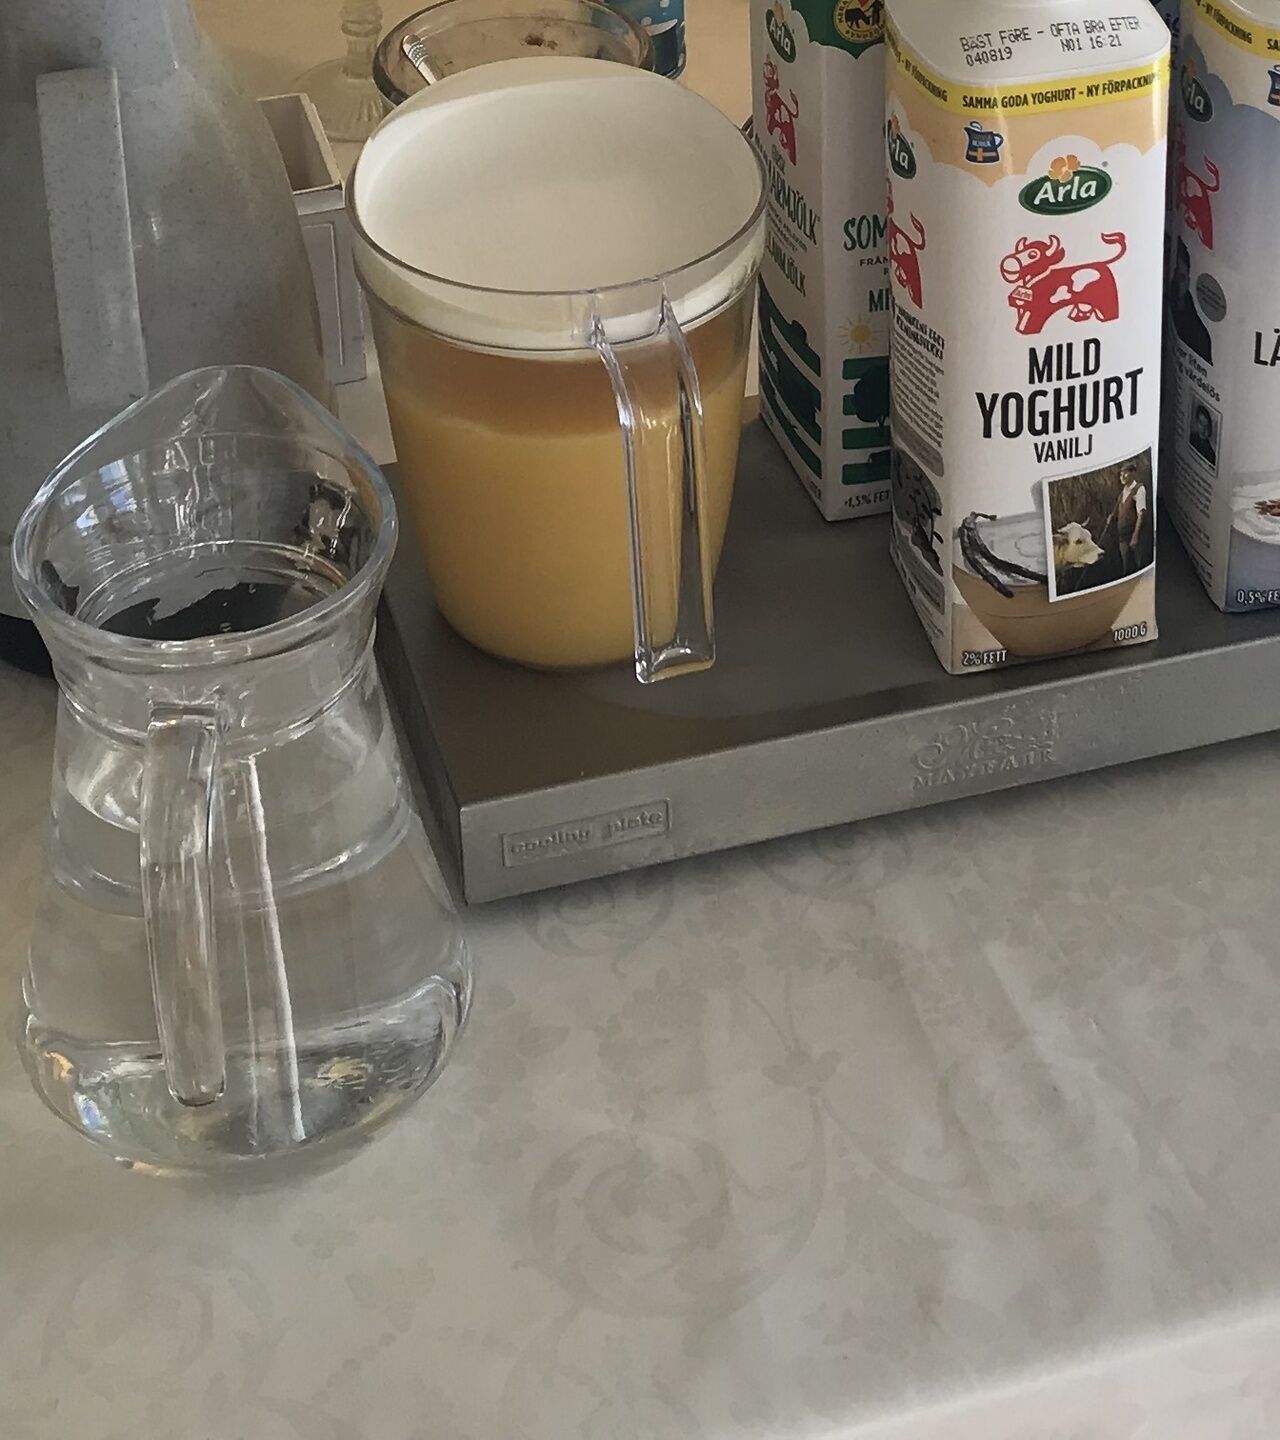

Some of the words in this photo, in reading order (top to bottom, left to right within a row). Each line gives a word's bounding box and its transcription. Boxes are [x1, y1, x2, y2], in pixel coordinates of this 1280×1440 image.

[1050, 22, 1080, 37] OFTA
[1083, 20, 1106, 34] BRA
[965, 46, 1013, 67] 040819
[962, 95, 999, 109] SAMMA
[1001, 94, 1029, 108] GODA
[1030, 87, 1077, 106] YOGHURT
[1086, 83, 1100, 98] NY
[1034, 177, 1098, 206] Arla
[1028, 337, 1101, 385] MILD
[975, 367, 1144, 439] YOGHURT
[1034, 434, 1093, 463] VANILJ
[873, 490, 890, 503] FET
[1113, 627, 1138, 642] 1000
[963, 651, 981, 666] 2%
[983, 650, 1007, 664] FETT
